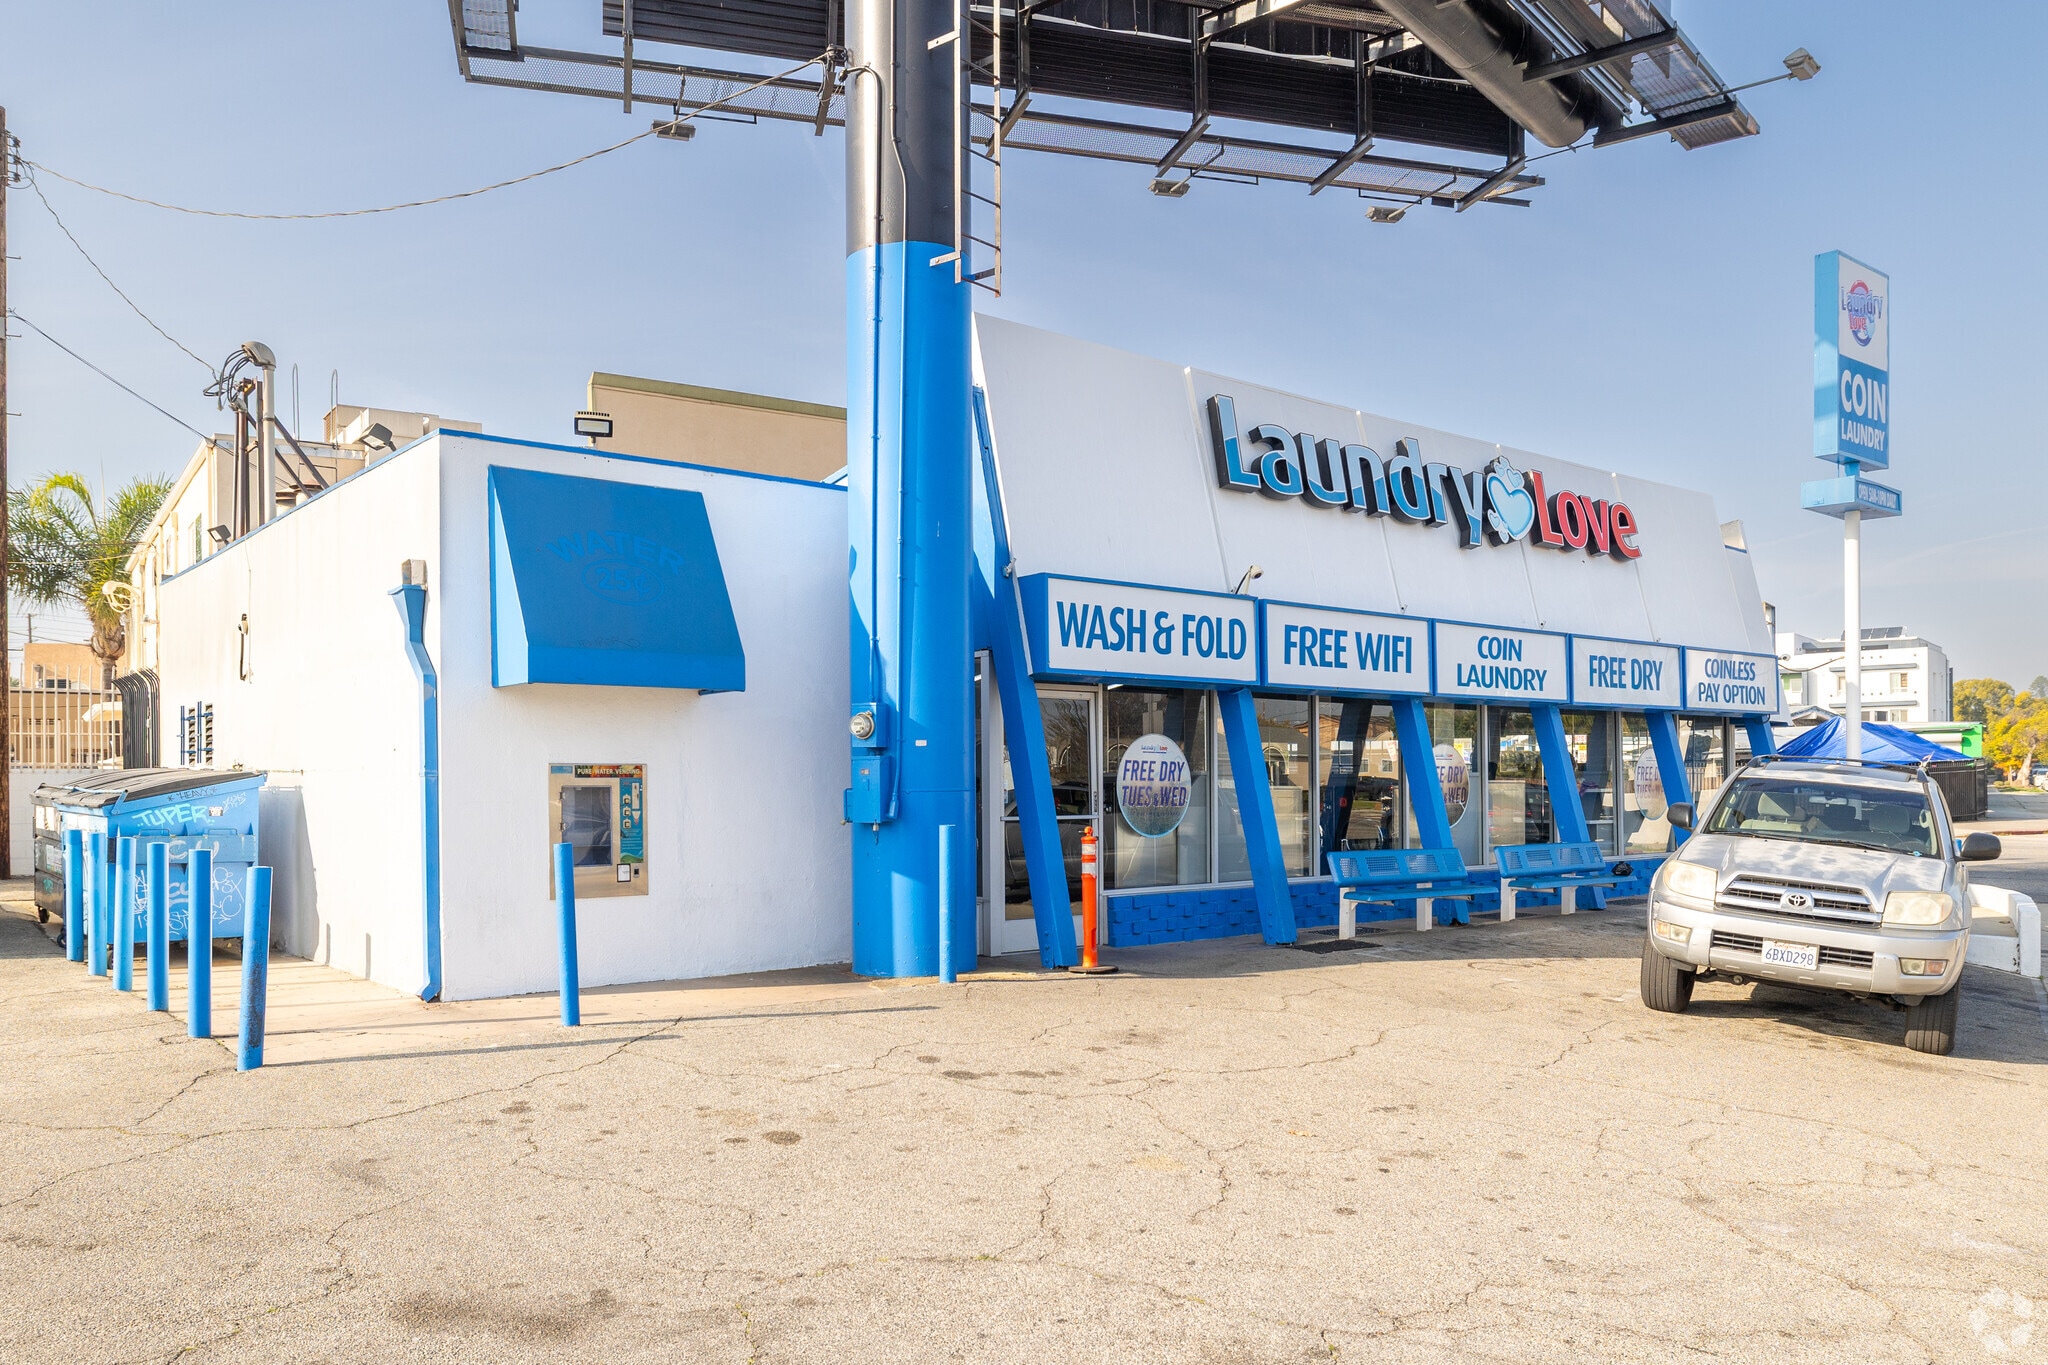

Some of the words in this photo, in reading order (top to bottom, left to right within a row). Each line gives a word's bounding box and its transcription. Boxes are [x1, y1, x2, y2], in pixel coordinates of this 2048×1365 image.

[1841, 286, 1883, 319] Laundry
[1841, 369, 1886, 424] COIN
[1841, 418, 1885, 451] LAUNDRY
[1207, 394, 1484, 550] Laundry
[1528, 468, 1641, 561] Love
[545, 529, 685, 576] WATER
[595, 567, 651, 598] 25¢
[1056, 601, 1146, 653] WASH
[1153, 611, 1175, 655] &
[1183, 614, 1247, 660] FOLD
[1284, 624, 1348, 669] FREE
[1355, 631, 1412, 674] WIFI
[1477, 635, 1522, 662] COIN
[1457, 663, 1547, 692] LAUNDRY
[1589, 655, 1626, 689] FREE
[1631, 658, 1663, 691] DRY
[1705, 658, 1756, 682] COINLESS
[1698, 682, 1721, 704] PAY
[1723, 684, 1766, 706] OPTION
[1123, 760, 1156, 781] FREE
[1159, 761, 1185, 782] DRY
[1447, 766, 1466, 783] DRY
[1637, 766, 1653, 781] FREE
[1122, 786, 1152, 806] TUES
[1160, 787, 1187, 806] WED
[1448, 786, 1467, 804] WED
[1765, 948, 1814, 966] 6BXD298
